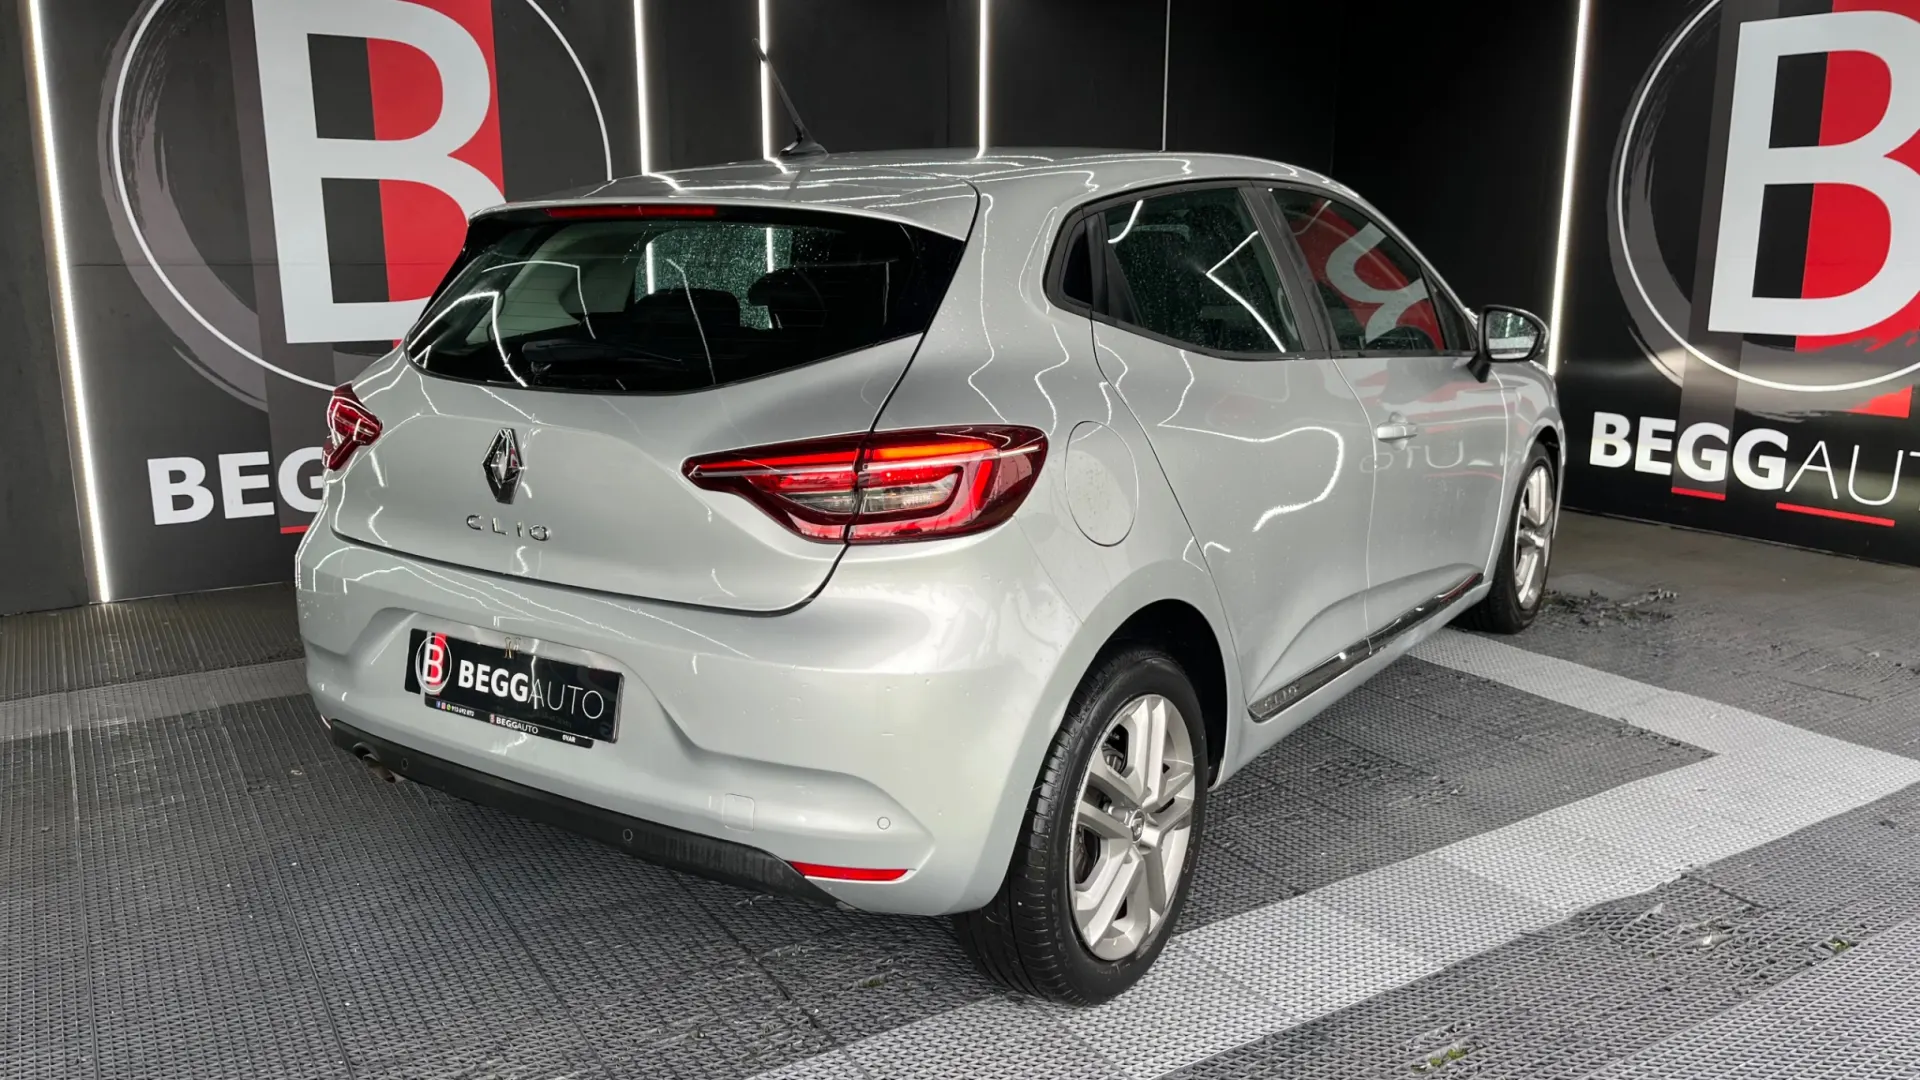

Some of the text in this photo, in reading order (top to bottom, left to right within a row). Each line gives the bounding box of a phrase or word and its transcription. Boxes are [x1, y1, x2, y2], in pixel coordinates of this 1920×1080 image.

[1590, 411, 1920, 511] BEGGAU
[466, 514, 551, 541] CLIO
[458, 659, 604, 719] BEGGAUTO
[496, 717, 539, 734] BEGGAUTO
